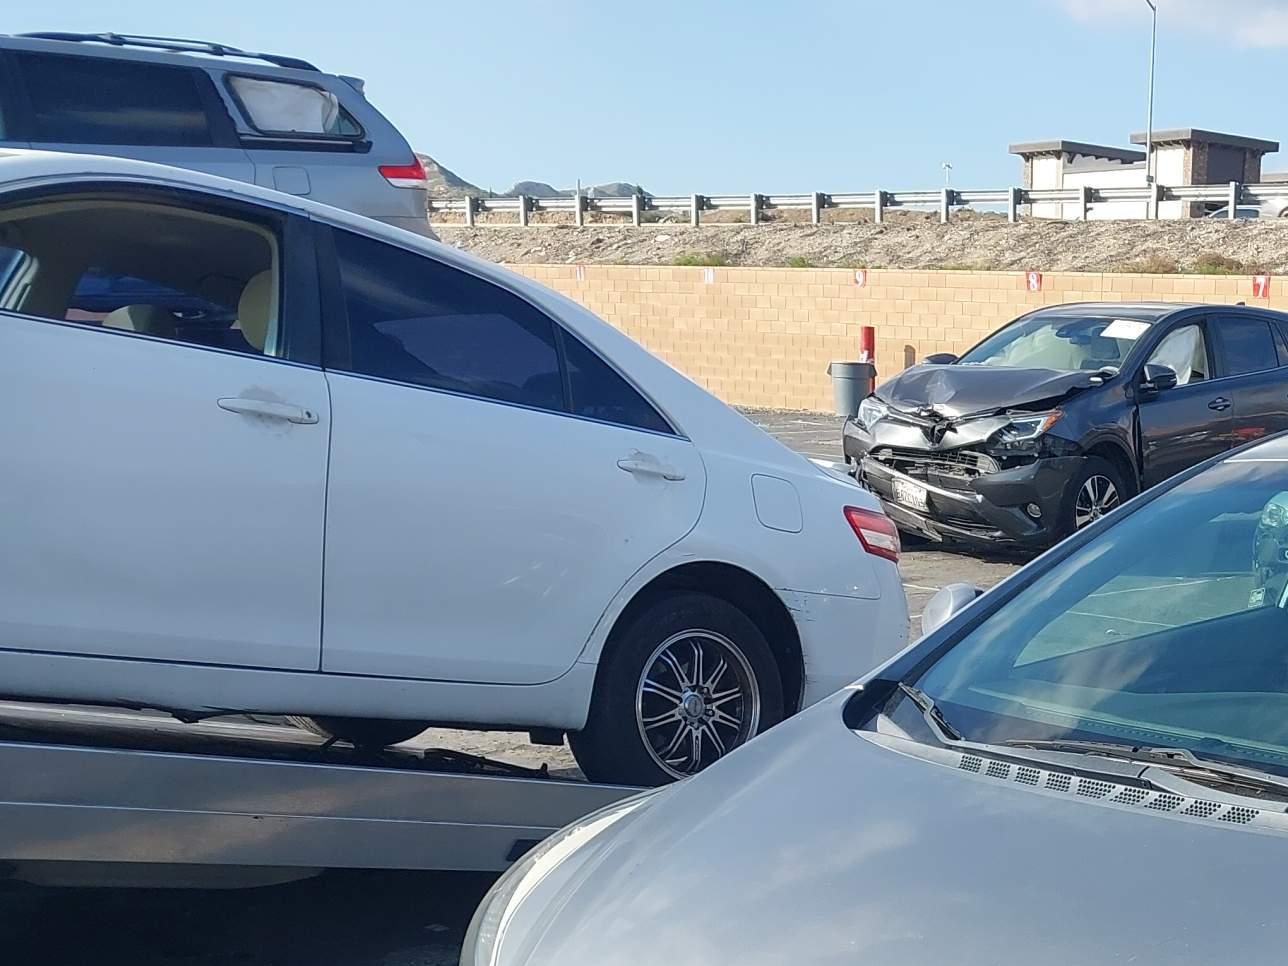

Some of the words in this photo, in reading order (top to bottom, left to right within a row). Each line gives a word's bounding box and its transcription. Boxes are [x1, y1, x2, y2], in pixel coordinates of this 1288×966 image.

[854, 270, 864, 288] 9
[1028, 273, 1038, 291] 8
[1255, 276, 1267, 298] 7
